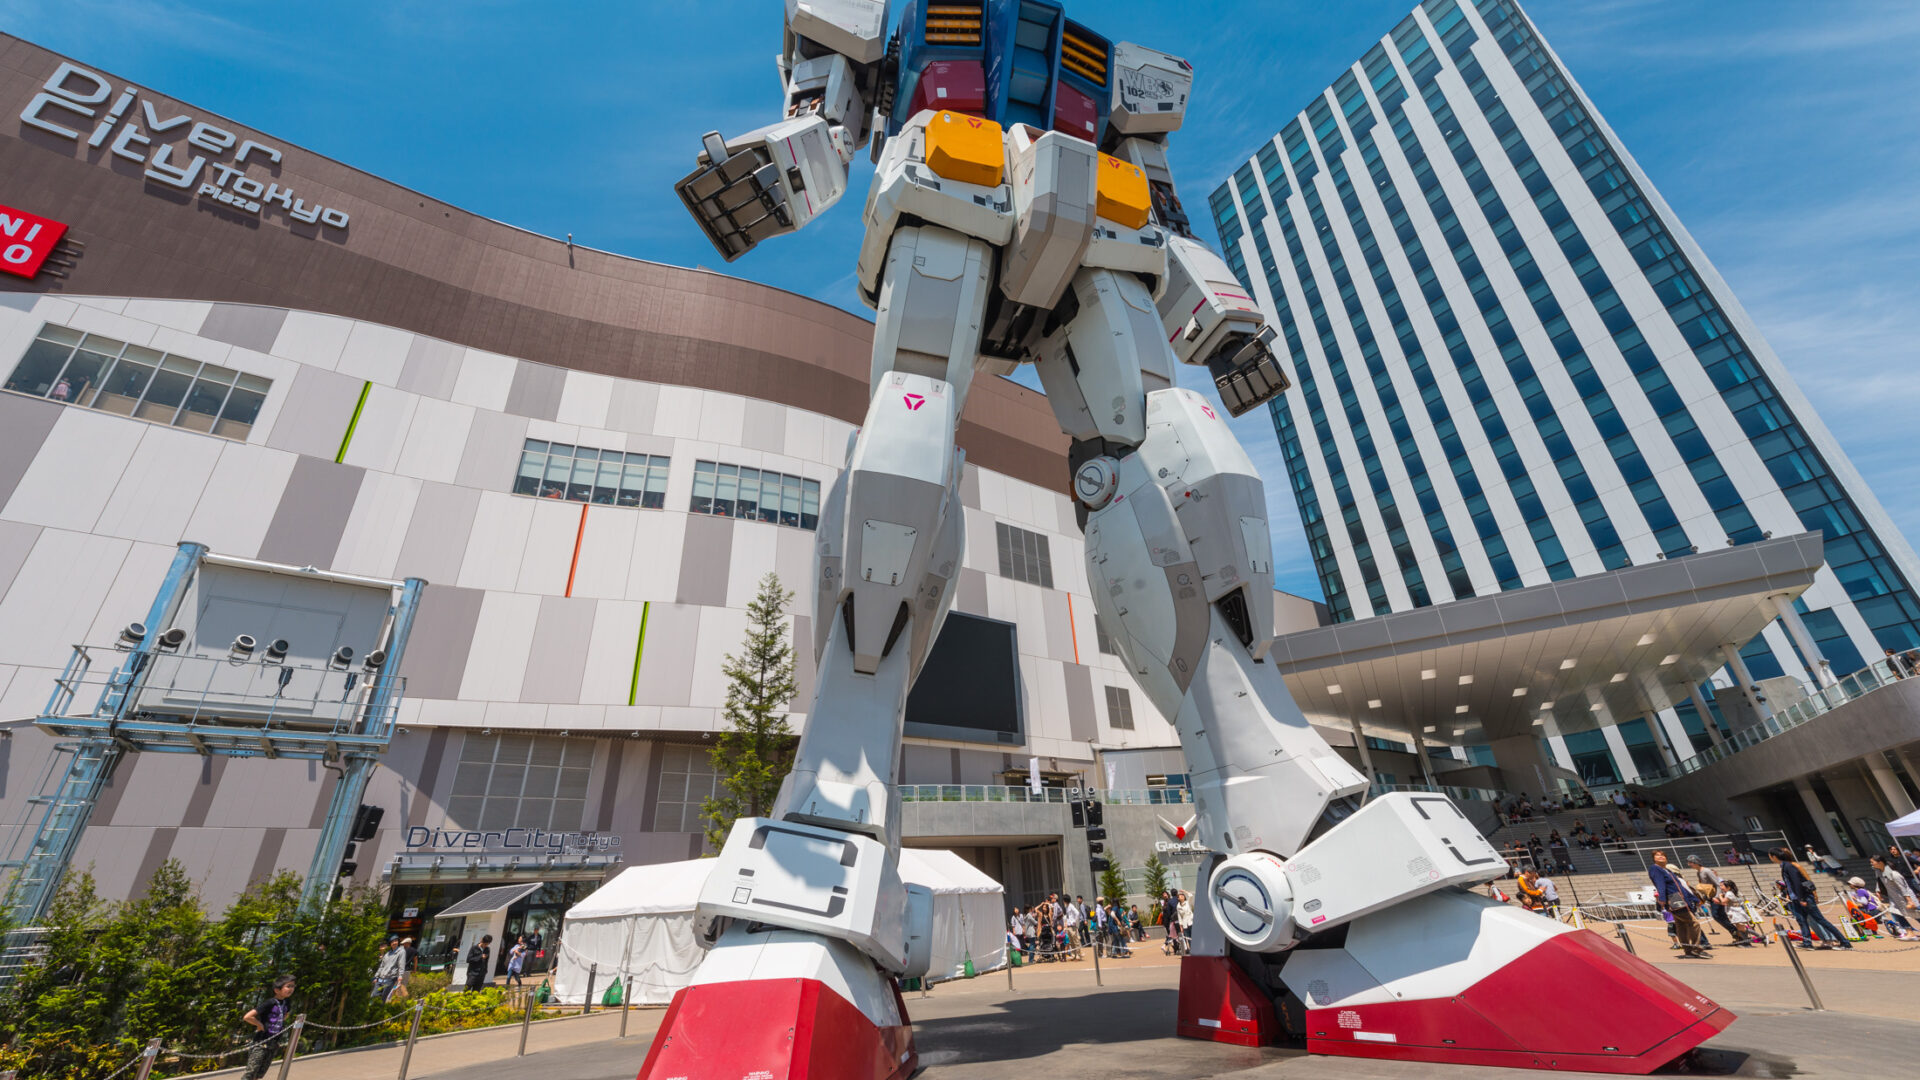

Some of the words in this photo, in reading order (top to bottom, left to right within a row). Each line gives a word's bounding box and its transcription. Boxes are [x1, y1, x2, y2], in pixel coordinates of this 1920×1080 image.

[43, 61, 282, 164] Diver
[1127, 86, 1146, 100] 102
[19, 91, 206, 189] City
[197, 182, 262, 214] Plaza
